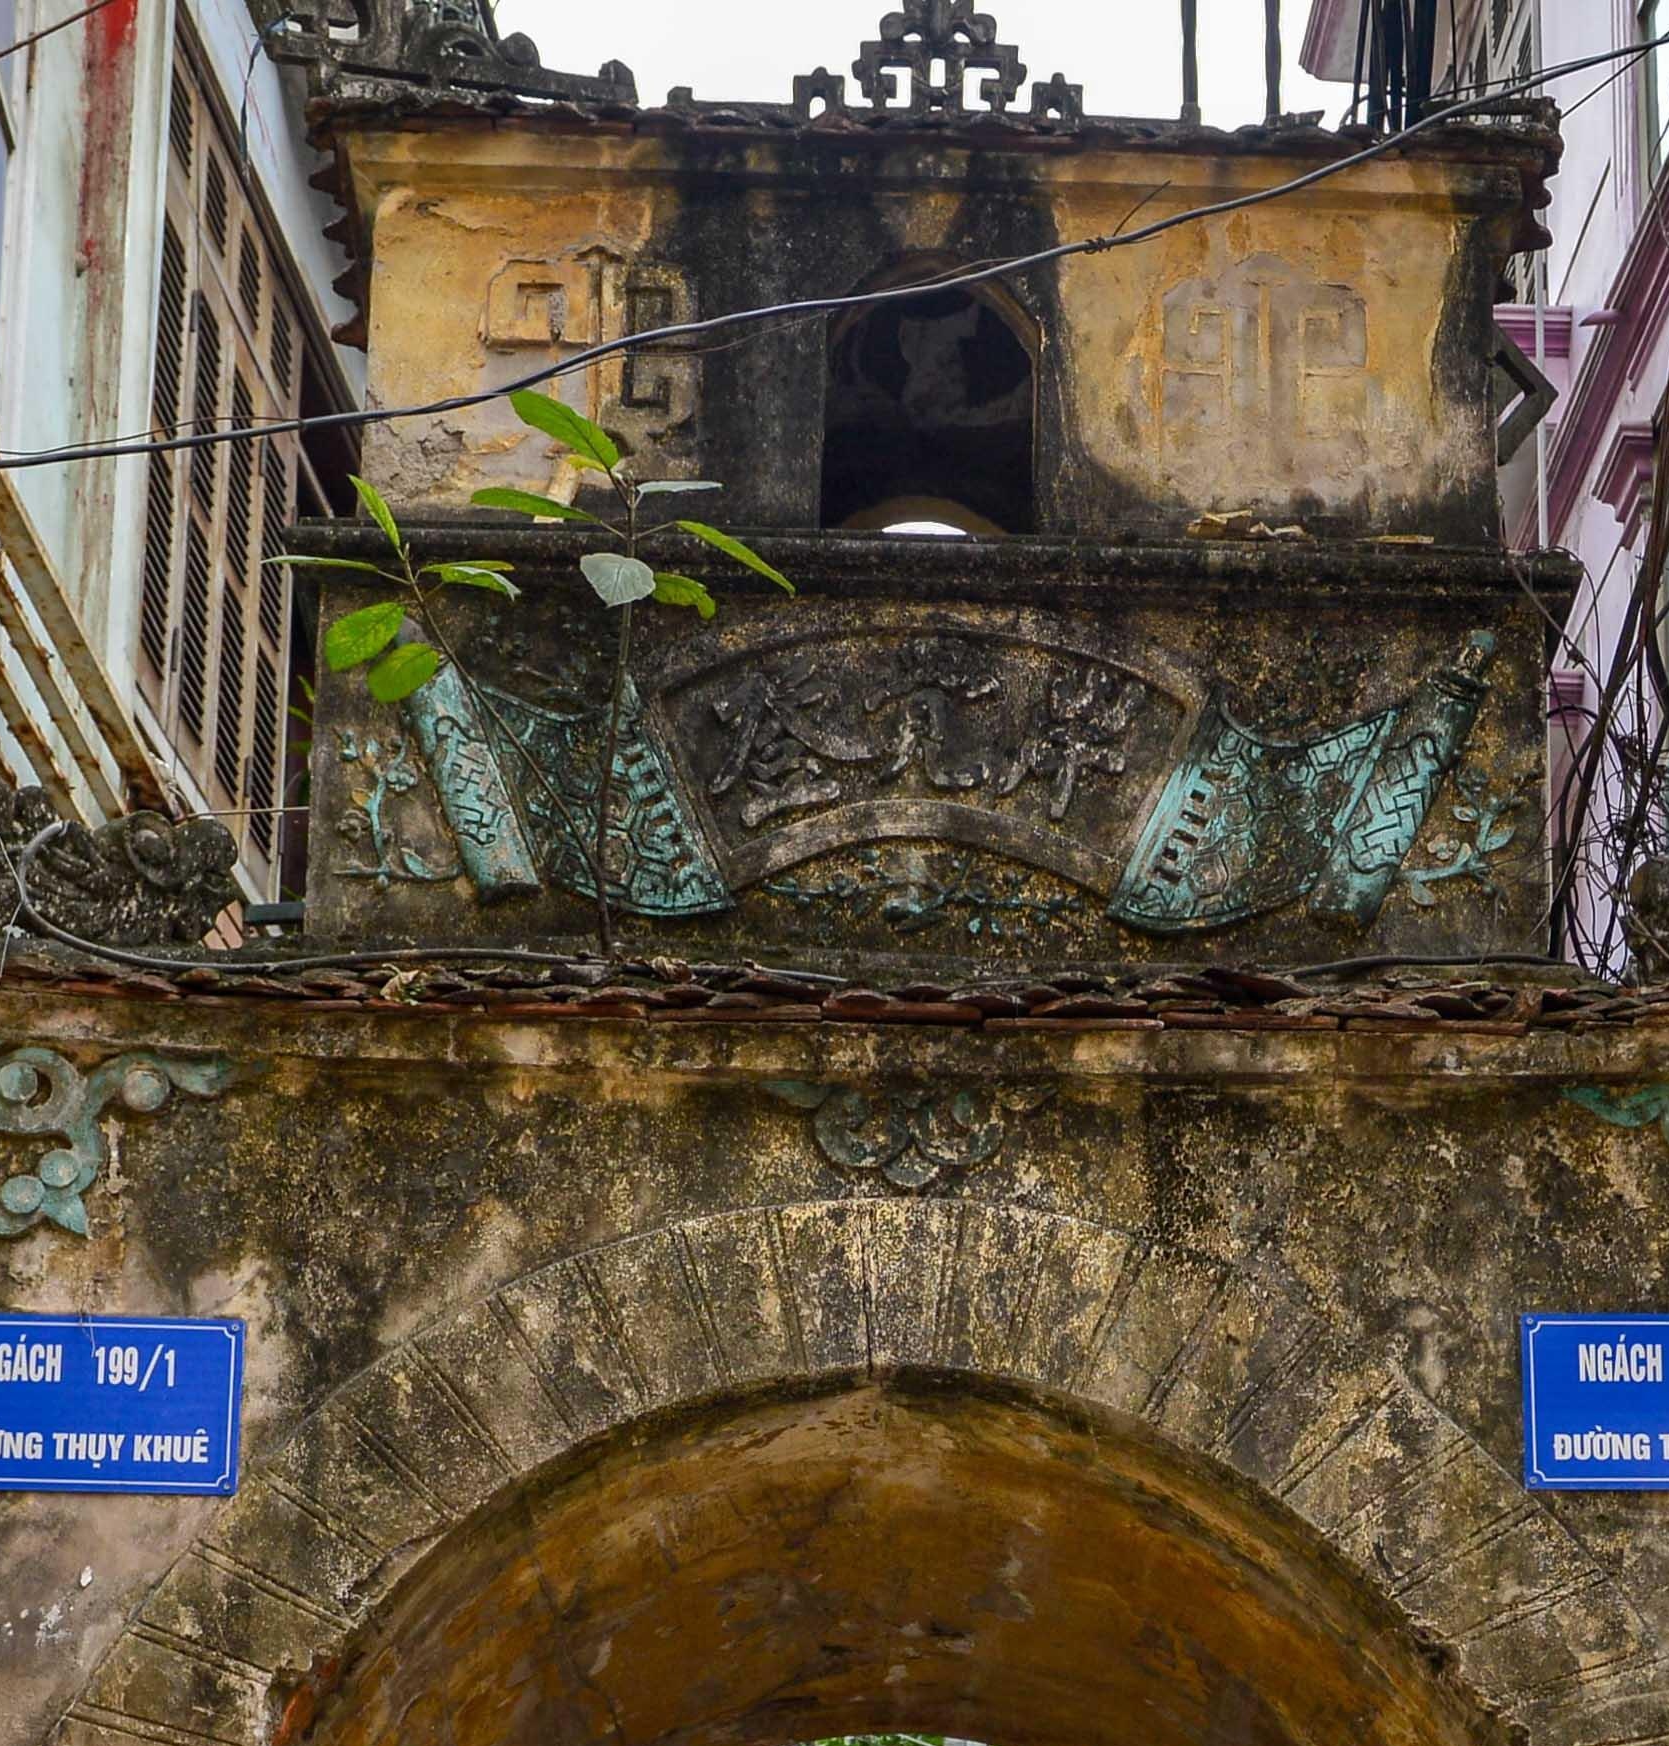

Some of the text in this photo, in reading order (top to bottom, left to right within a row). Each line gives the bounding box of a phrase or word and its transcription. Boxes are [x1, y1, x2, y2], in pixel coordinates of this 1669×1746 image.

[93, 1343, 177, 1392] 199/1
[1578, 1333, 1663, 1382] NGÁCH
[52, 1431, 125, 1469] THỤY
[133, 1428, 210, 1463] KHUÊ
[1553, 1424, 1651, 1461] ĐƯỜNG
